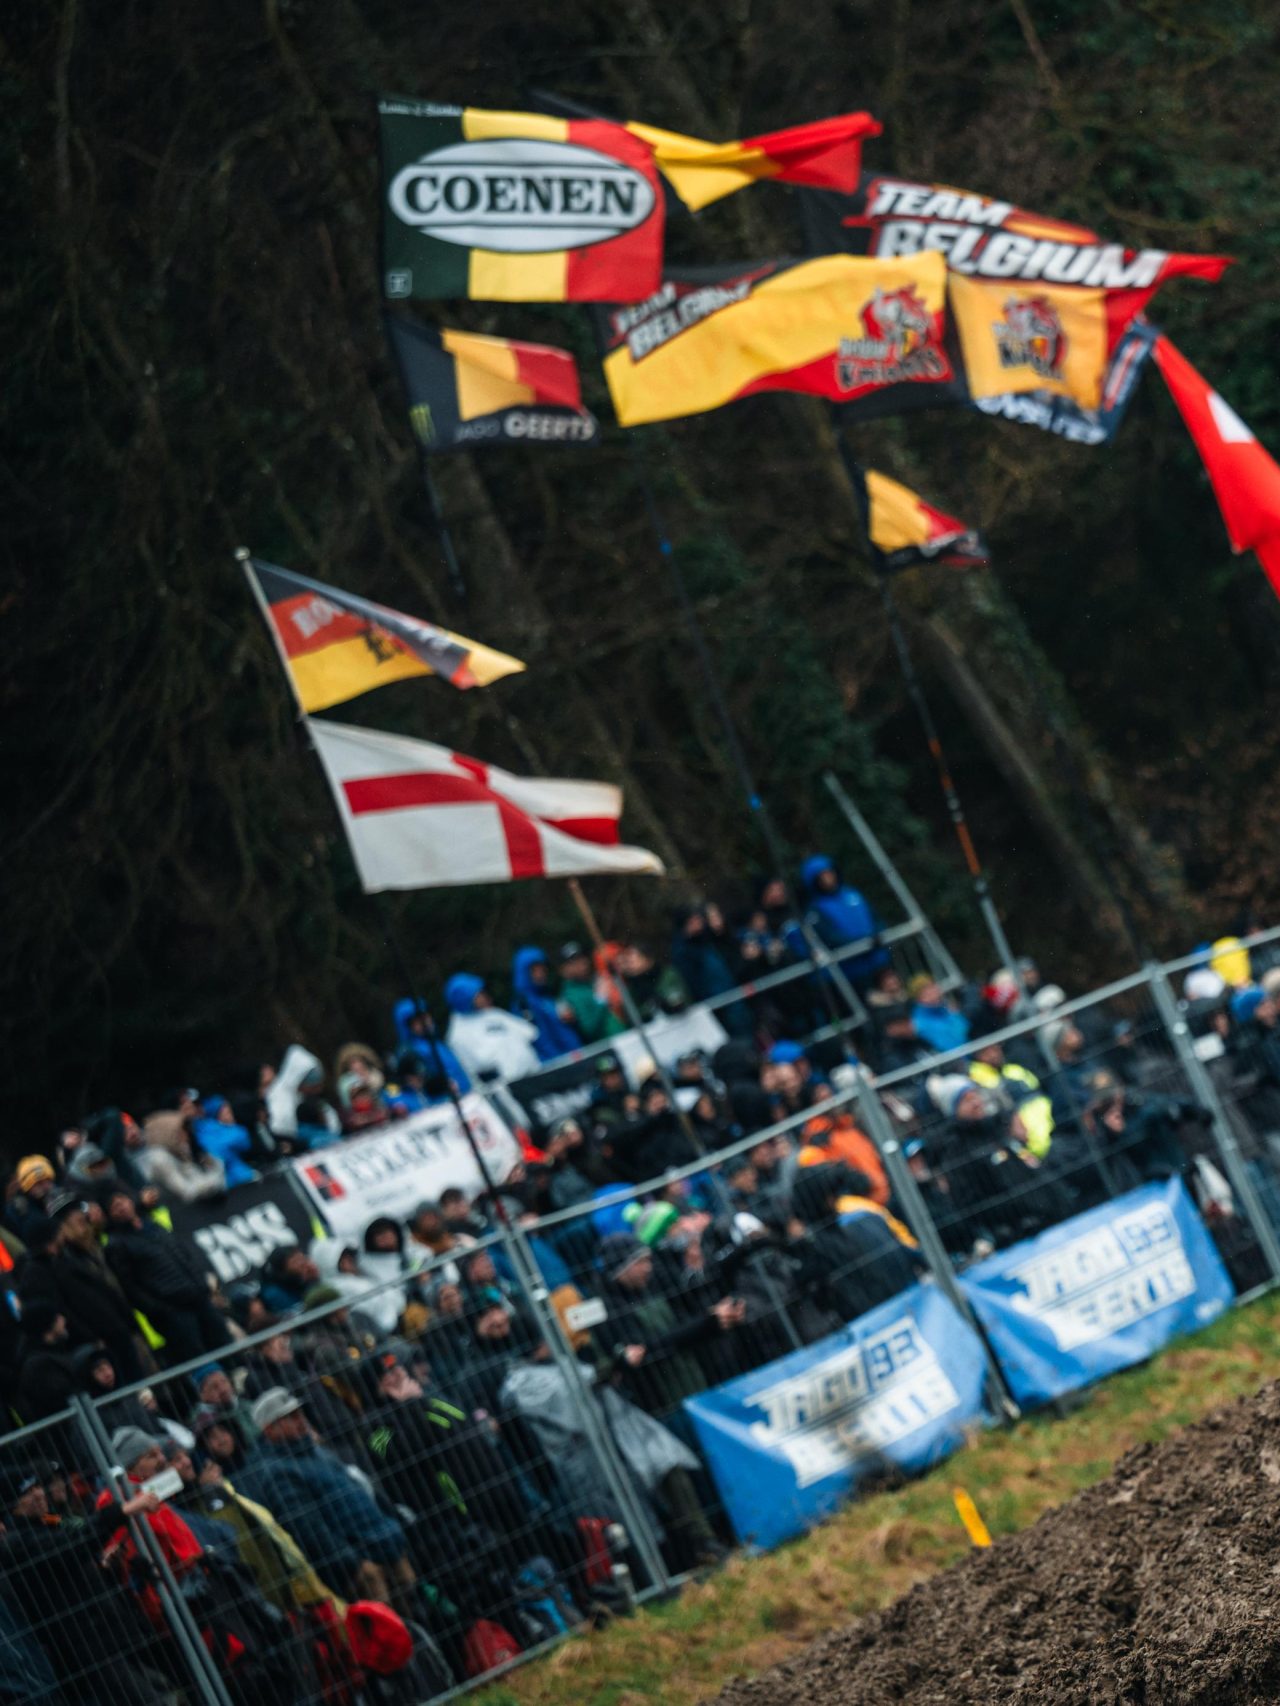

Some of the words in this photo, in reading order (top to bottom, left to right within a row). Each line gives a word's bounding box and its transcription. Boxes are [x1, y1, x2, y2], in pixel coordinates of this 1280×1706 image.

[405, 174, 639, 216] COENEN
[870, 181, 1015, 227] TEAM
[876, 219, 1170, 288] BELGIUM
[503, 410, 596, 442] GEERTS
